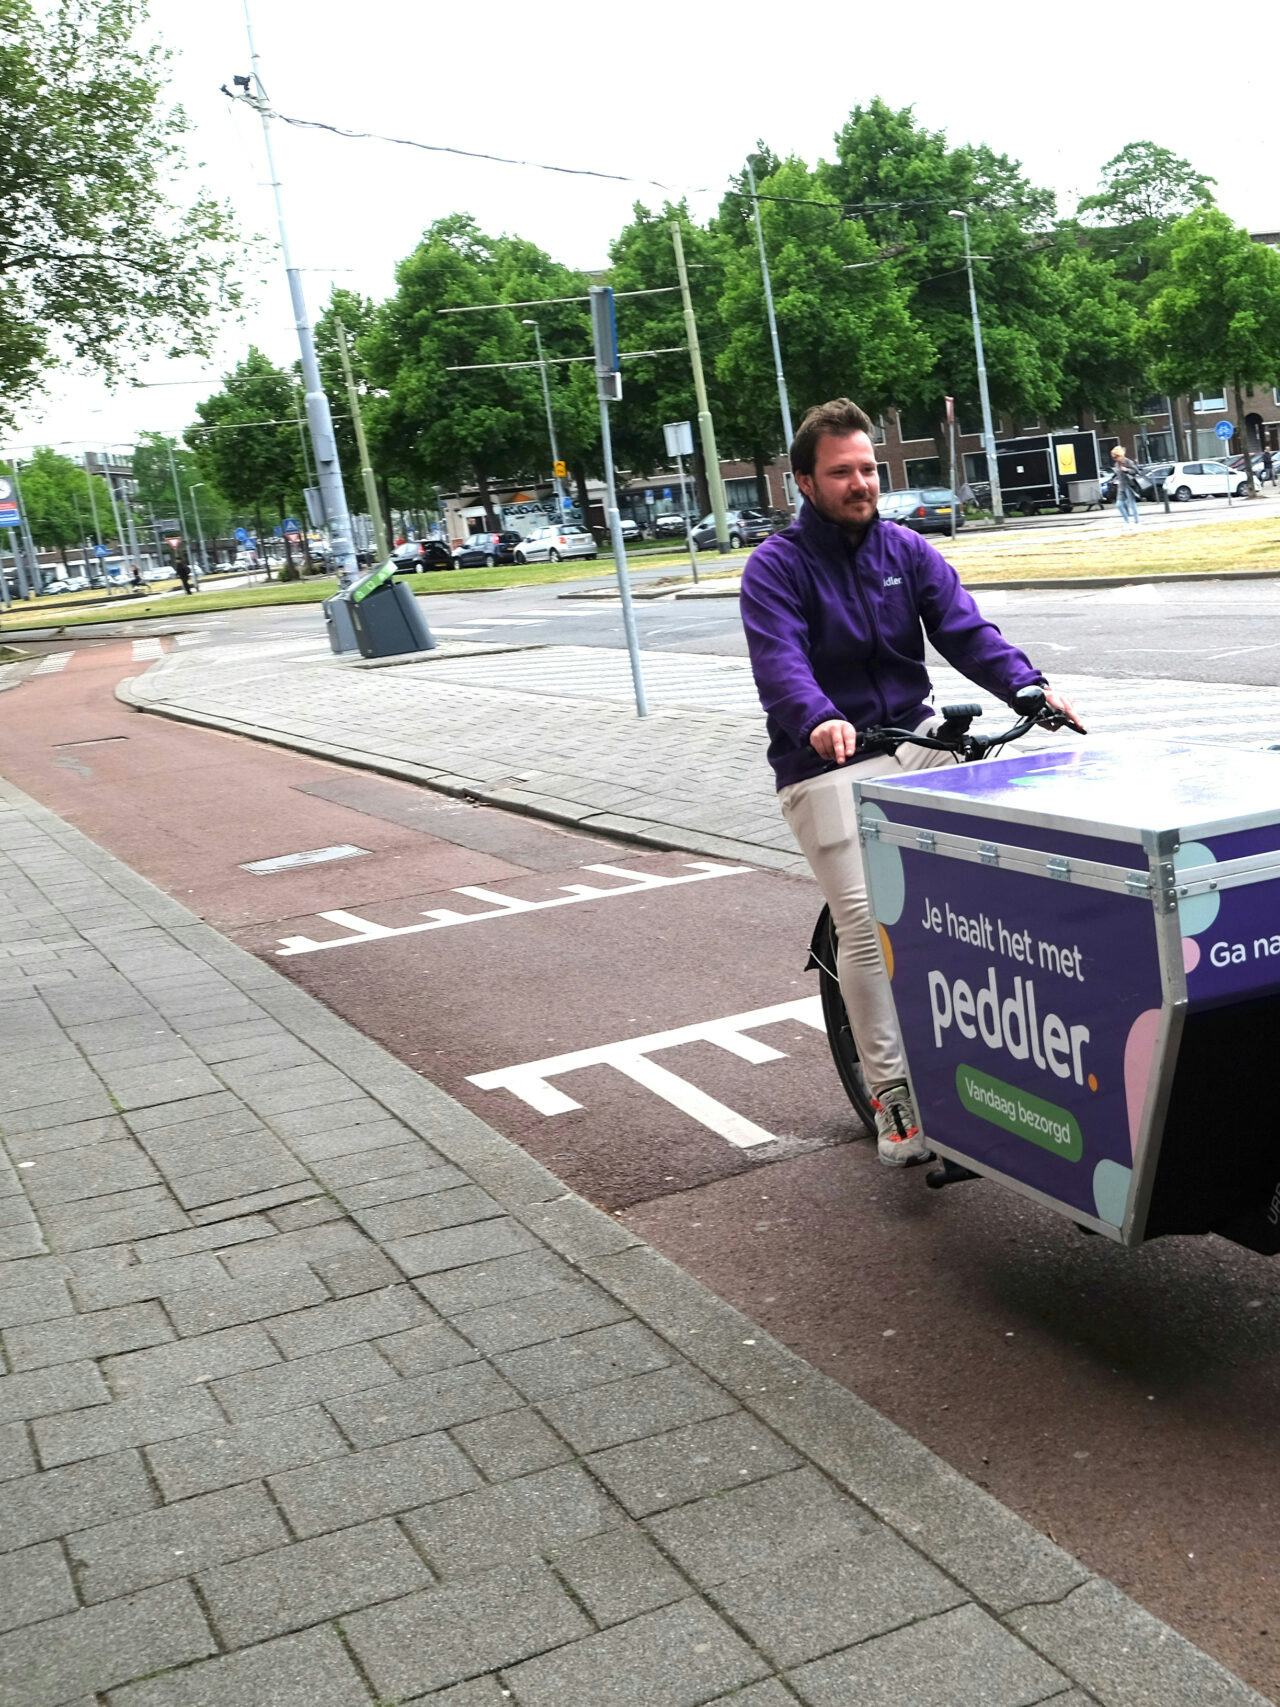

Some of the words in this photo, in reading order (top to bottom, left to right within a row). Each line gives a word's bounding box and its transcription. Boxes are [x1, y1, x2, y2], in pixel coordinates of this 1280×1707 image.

[921, 897, 943, 933] Je
[945, 902, 995, 951] haalt
[998, 918, 1034, 965] het
[1038, 941, 1085, 982] met
[1210, 941, 1247, 967] Ga
[965, 1077, 1016, 1122] Vandaag
[1017, 1101, 1071, 1144] bezorgd
